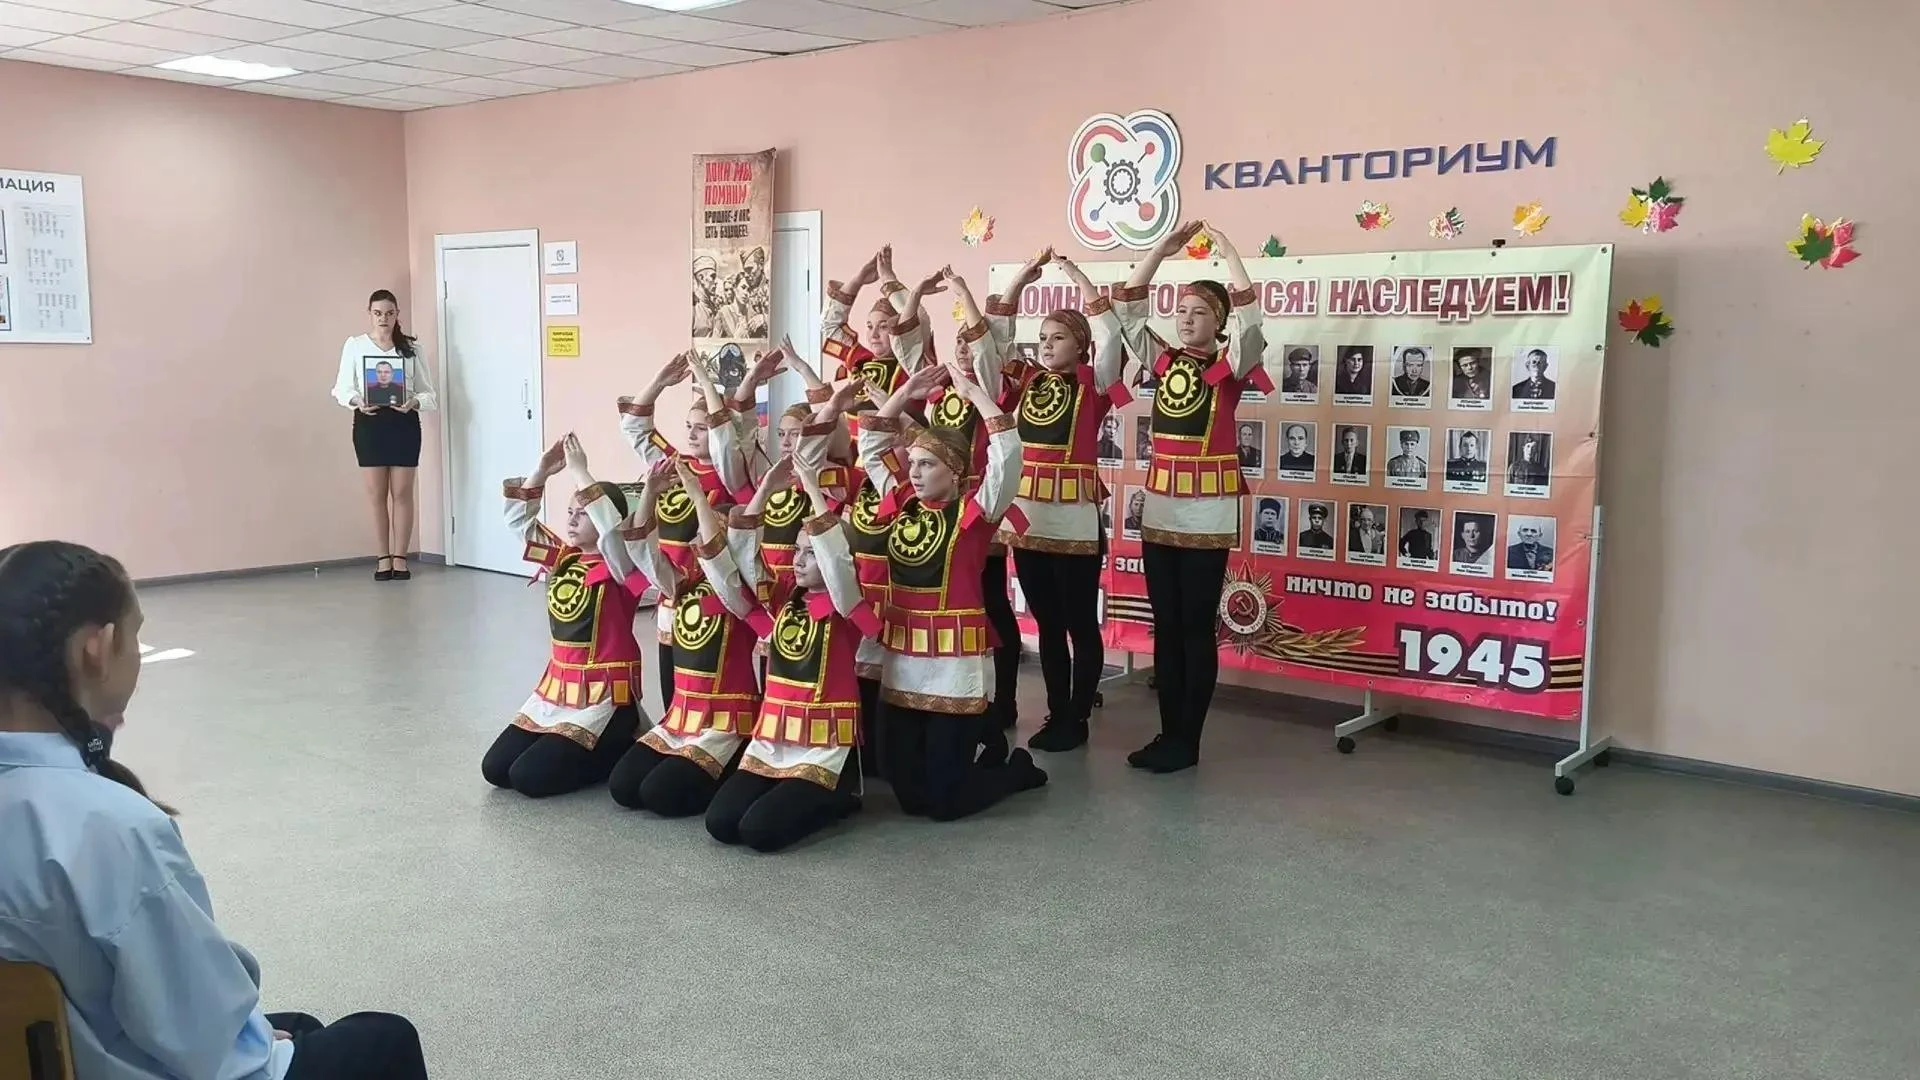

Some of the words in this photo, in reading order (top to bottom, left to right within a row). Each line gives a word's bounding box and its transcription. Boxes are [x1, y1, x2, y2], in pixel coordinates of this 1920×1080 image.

[1204, 136, 1558, 190] КВАНТОРИУМ
[704, 184, 747, 205] ПОМНИМ
[1328, 272, 1570, 321] НАСЛЕДУЕМ!
[1286, 575, 1373, 601] ничто
[1384, 586, 1415, 606] не
[1425, 590, 1558, 621] забыто!
[1400, 629, 1546, 690] 1945
